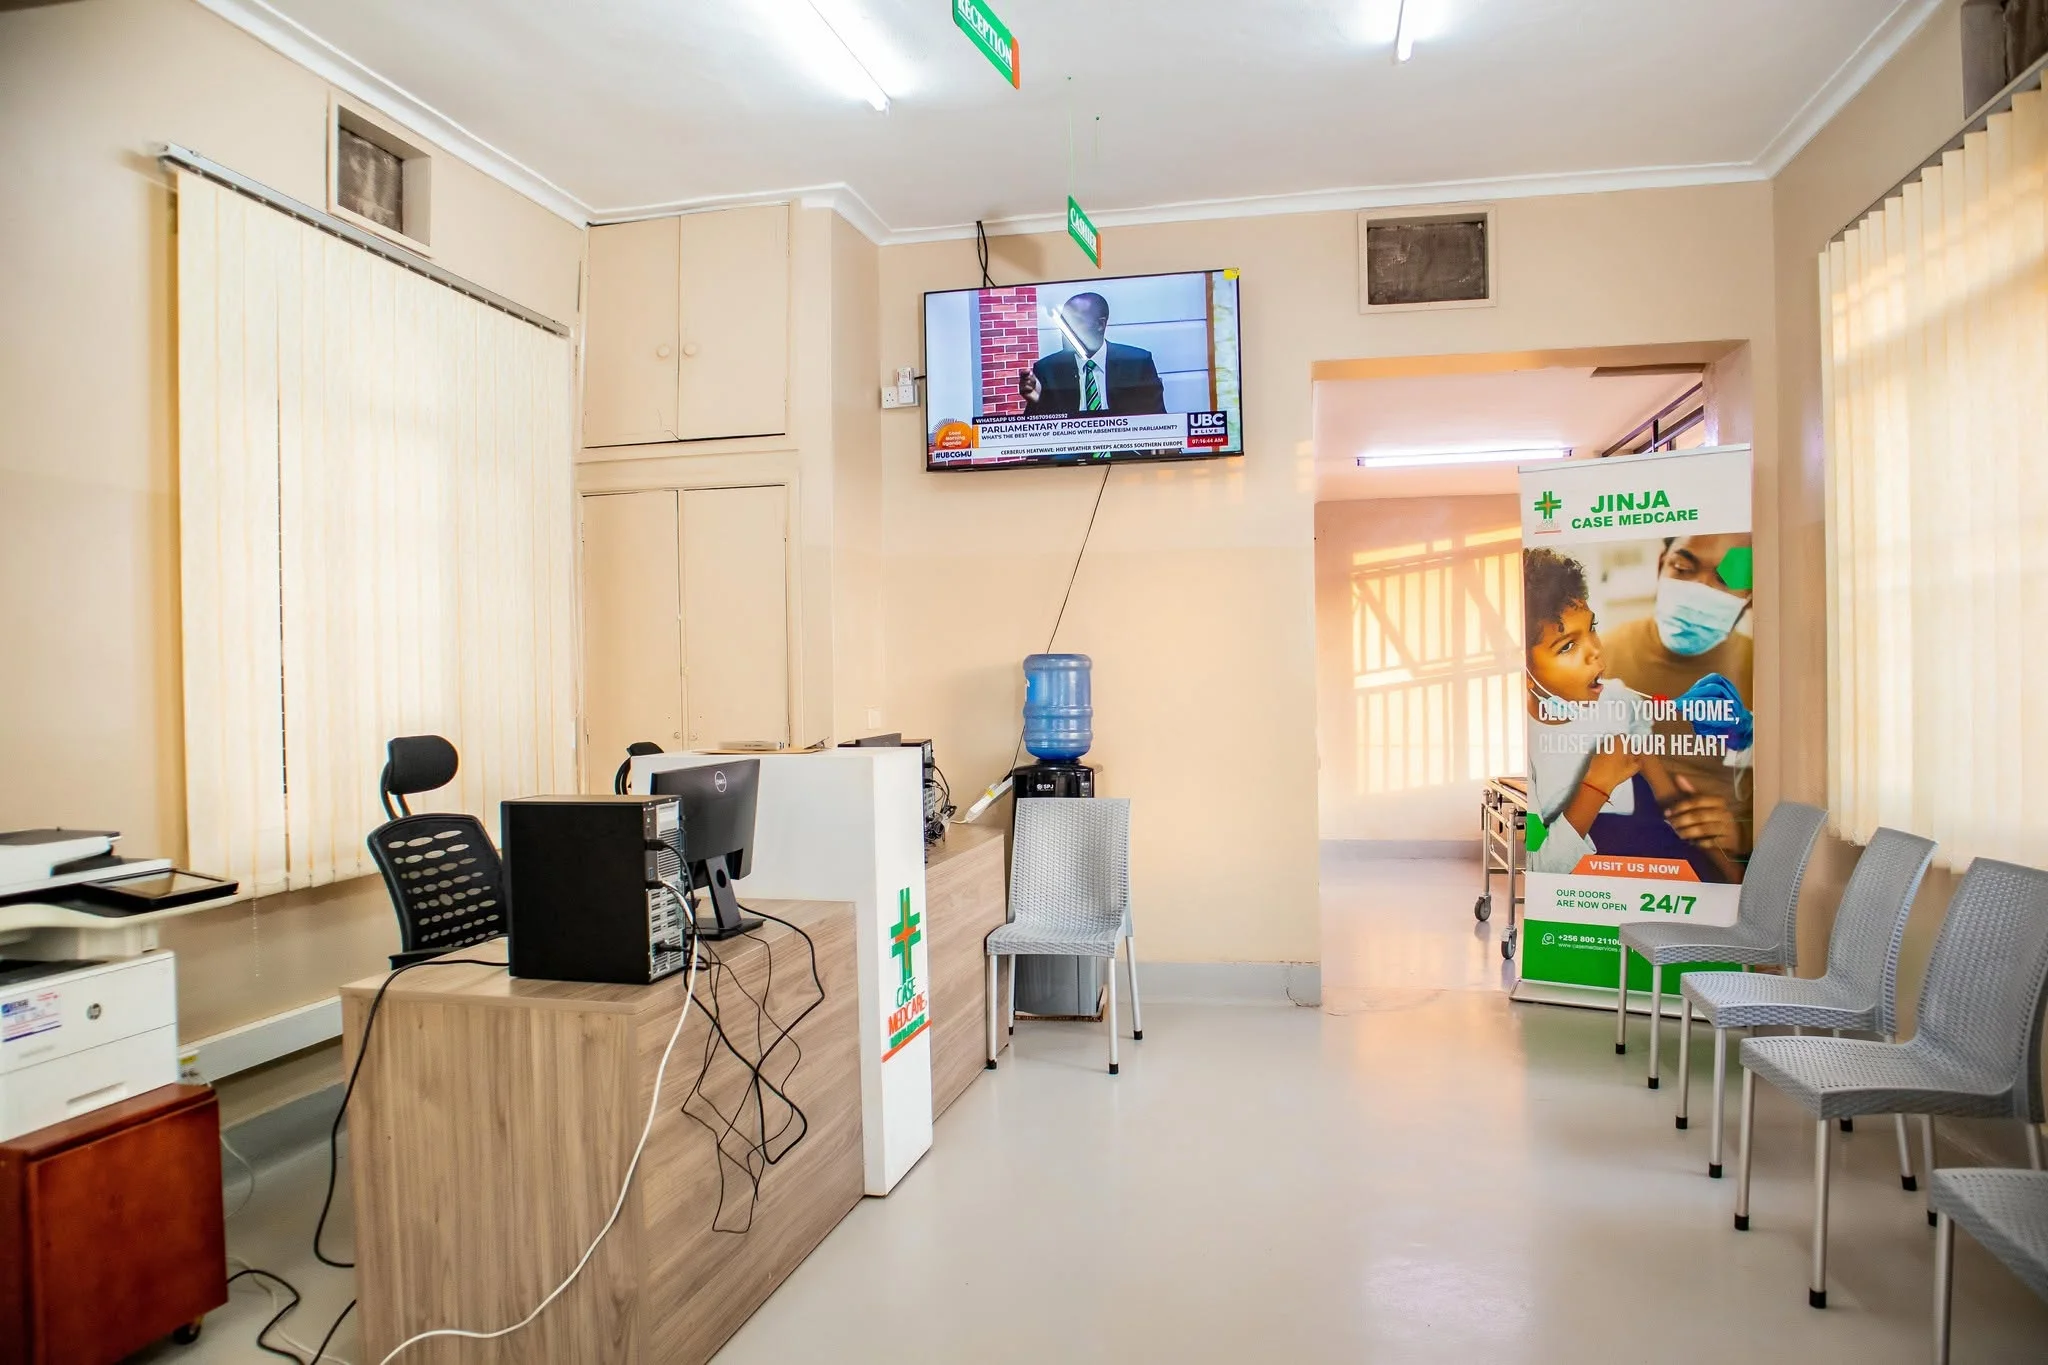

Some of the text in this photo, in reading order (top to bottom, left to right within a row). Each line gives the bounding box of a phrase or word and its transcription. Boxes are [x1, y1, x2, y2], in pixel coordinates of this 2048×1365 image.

[981, 418, 1128, 434] PARLIAMENTARY PROCEEDINGS
[1190, 413, 1224, 427] UBC
[935, 450, 972, 458] #UBCGMU
[1590, 490, 1670, 513] JINJA
[1571, 516, 1613, 529] CASE
[1619, 509, 1698, 526] MEDCARE
[1538, 700, 1740, 724] CLOSER TO YOUR HOME,
[1538, 733, 1729, 756] CLOSE TO YOUR HEART
[1590, 861, 1680, 875] VISIT US NOW
[1556, 889, 1611, 899] OUR DOORS
[1556, 899, 1627, 911] ARE NOW OPEN
[1640, 893, 1697, 914] 24/7
[1558, 934, 1577, 942] +256
[1580, 936, 1595, 944] 800
[896, 977, 916, 1007] CASE
[887, 991, 926, 1036] MEDCARE
